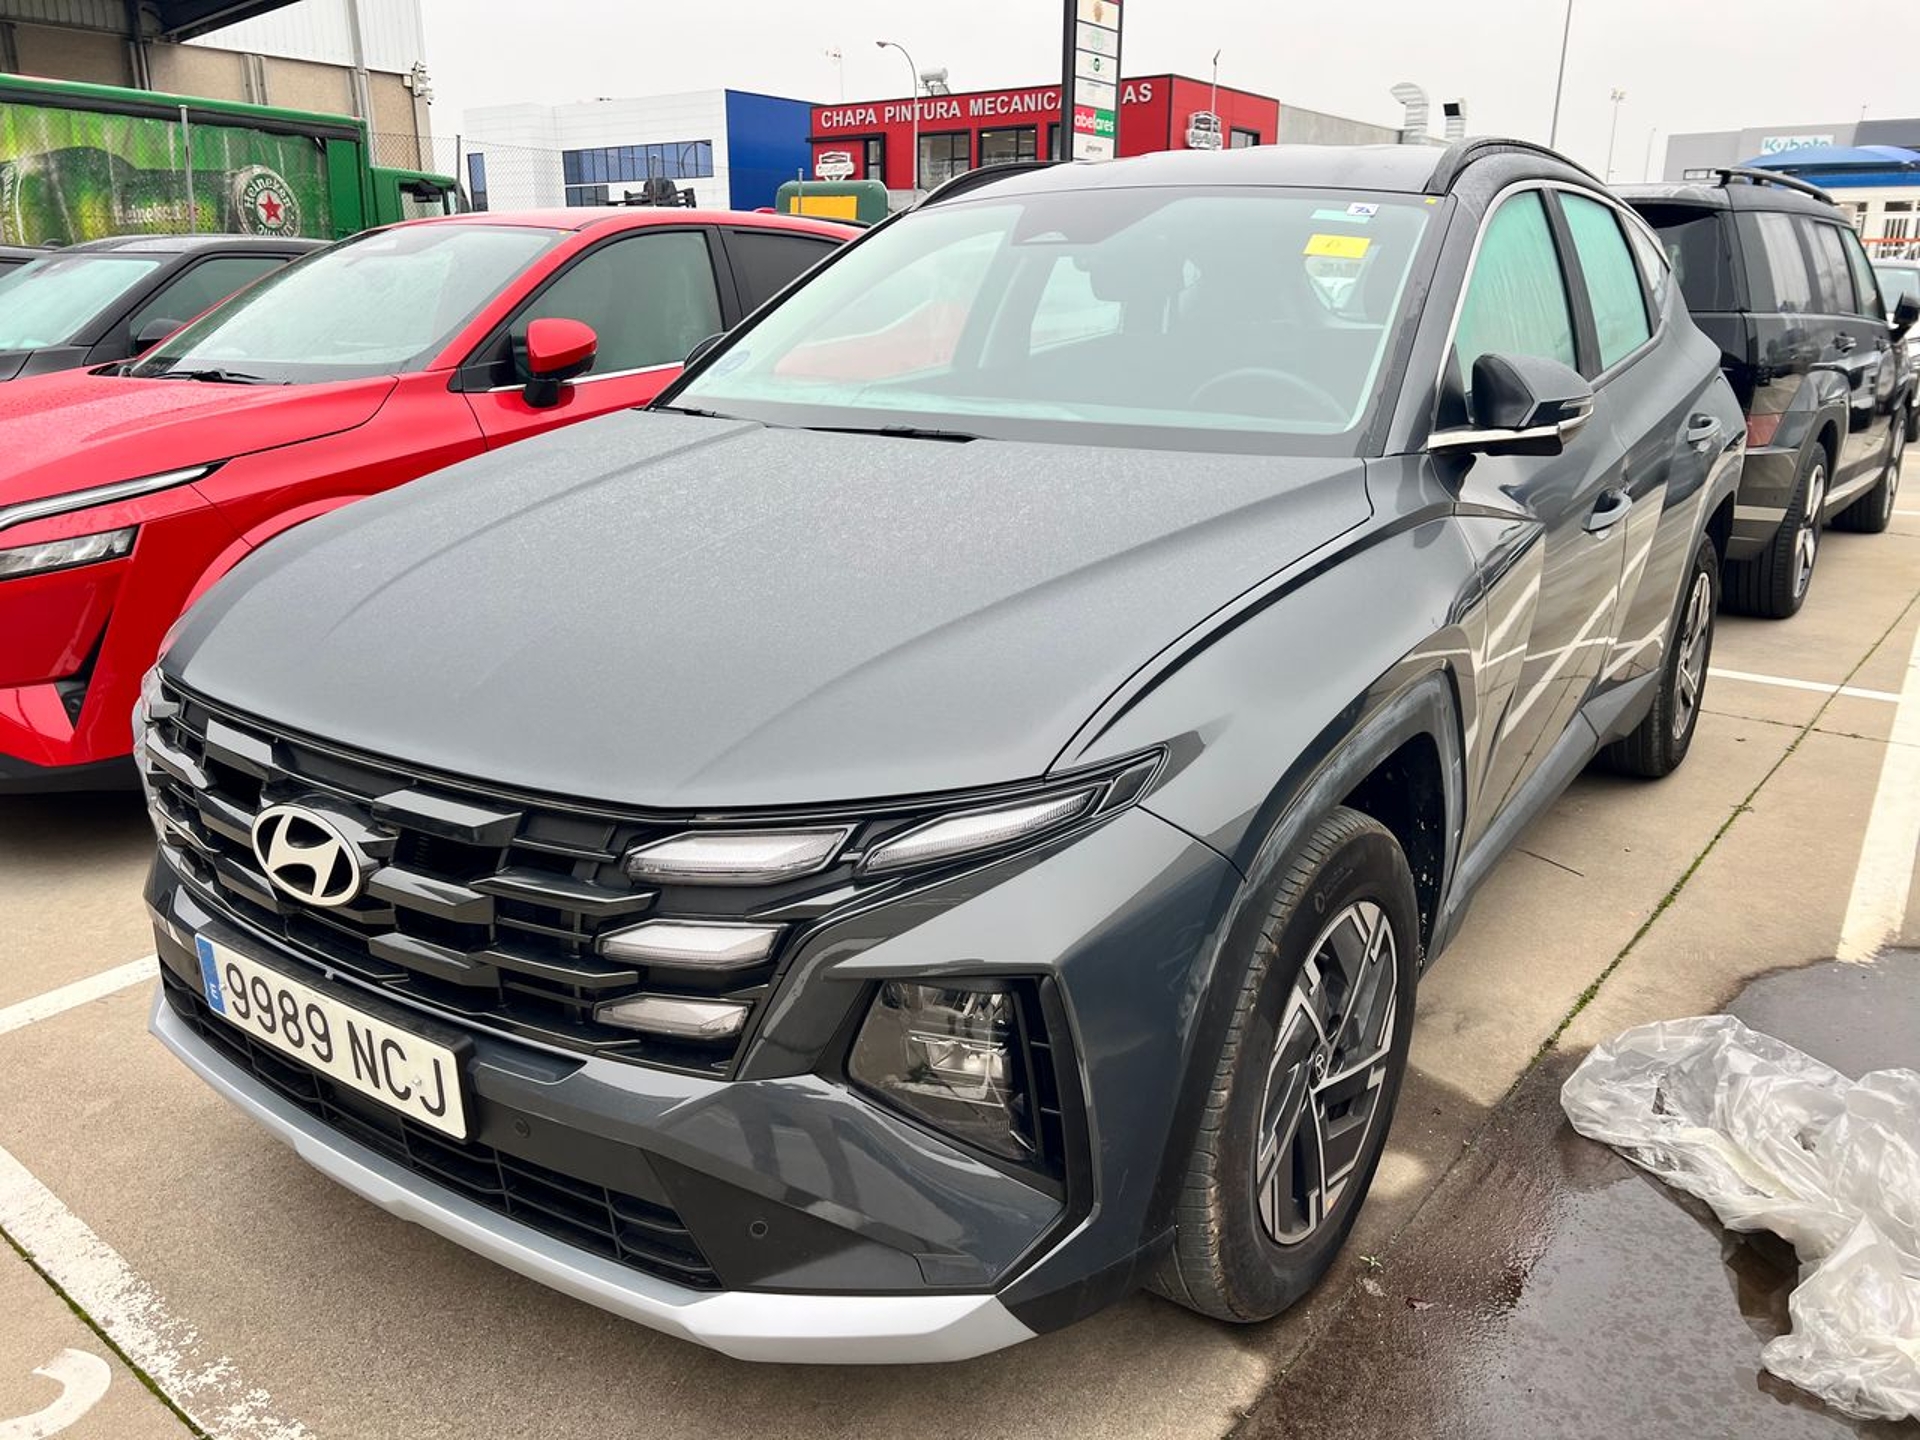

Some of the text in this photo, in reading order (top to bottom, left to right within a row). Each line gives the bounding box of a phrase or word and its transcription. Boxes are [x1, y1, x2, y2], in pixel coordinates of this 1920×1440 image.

[821, 107, 877, 128] CHAPA
[885, 100, 961, 123] PINTURA
[243, 178, 292, 208] Heineken
[225, 962, 447, 1118] 9989 NCJ
